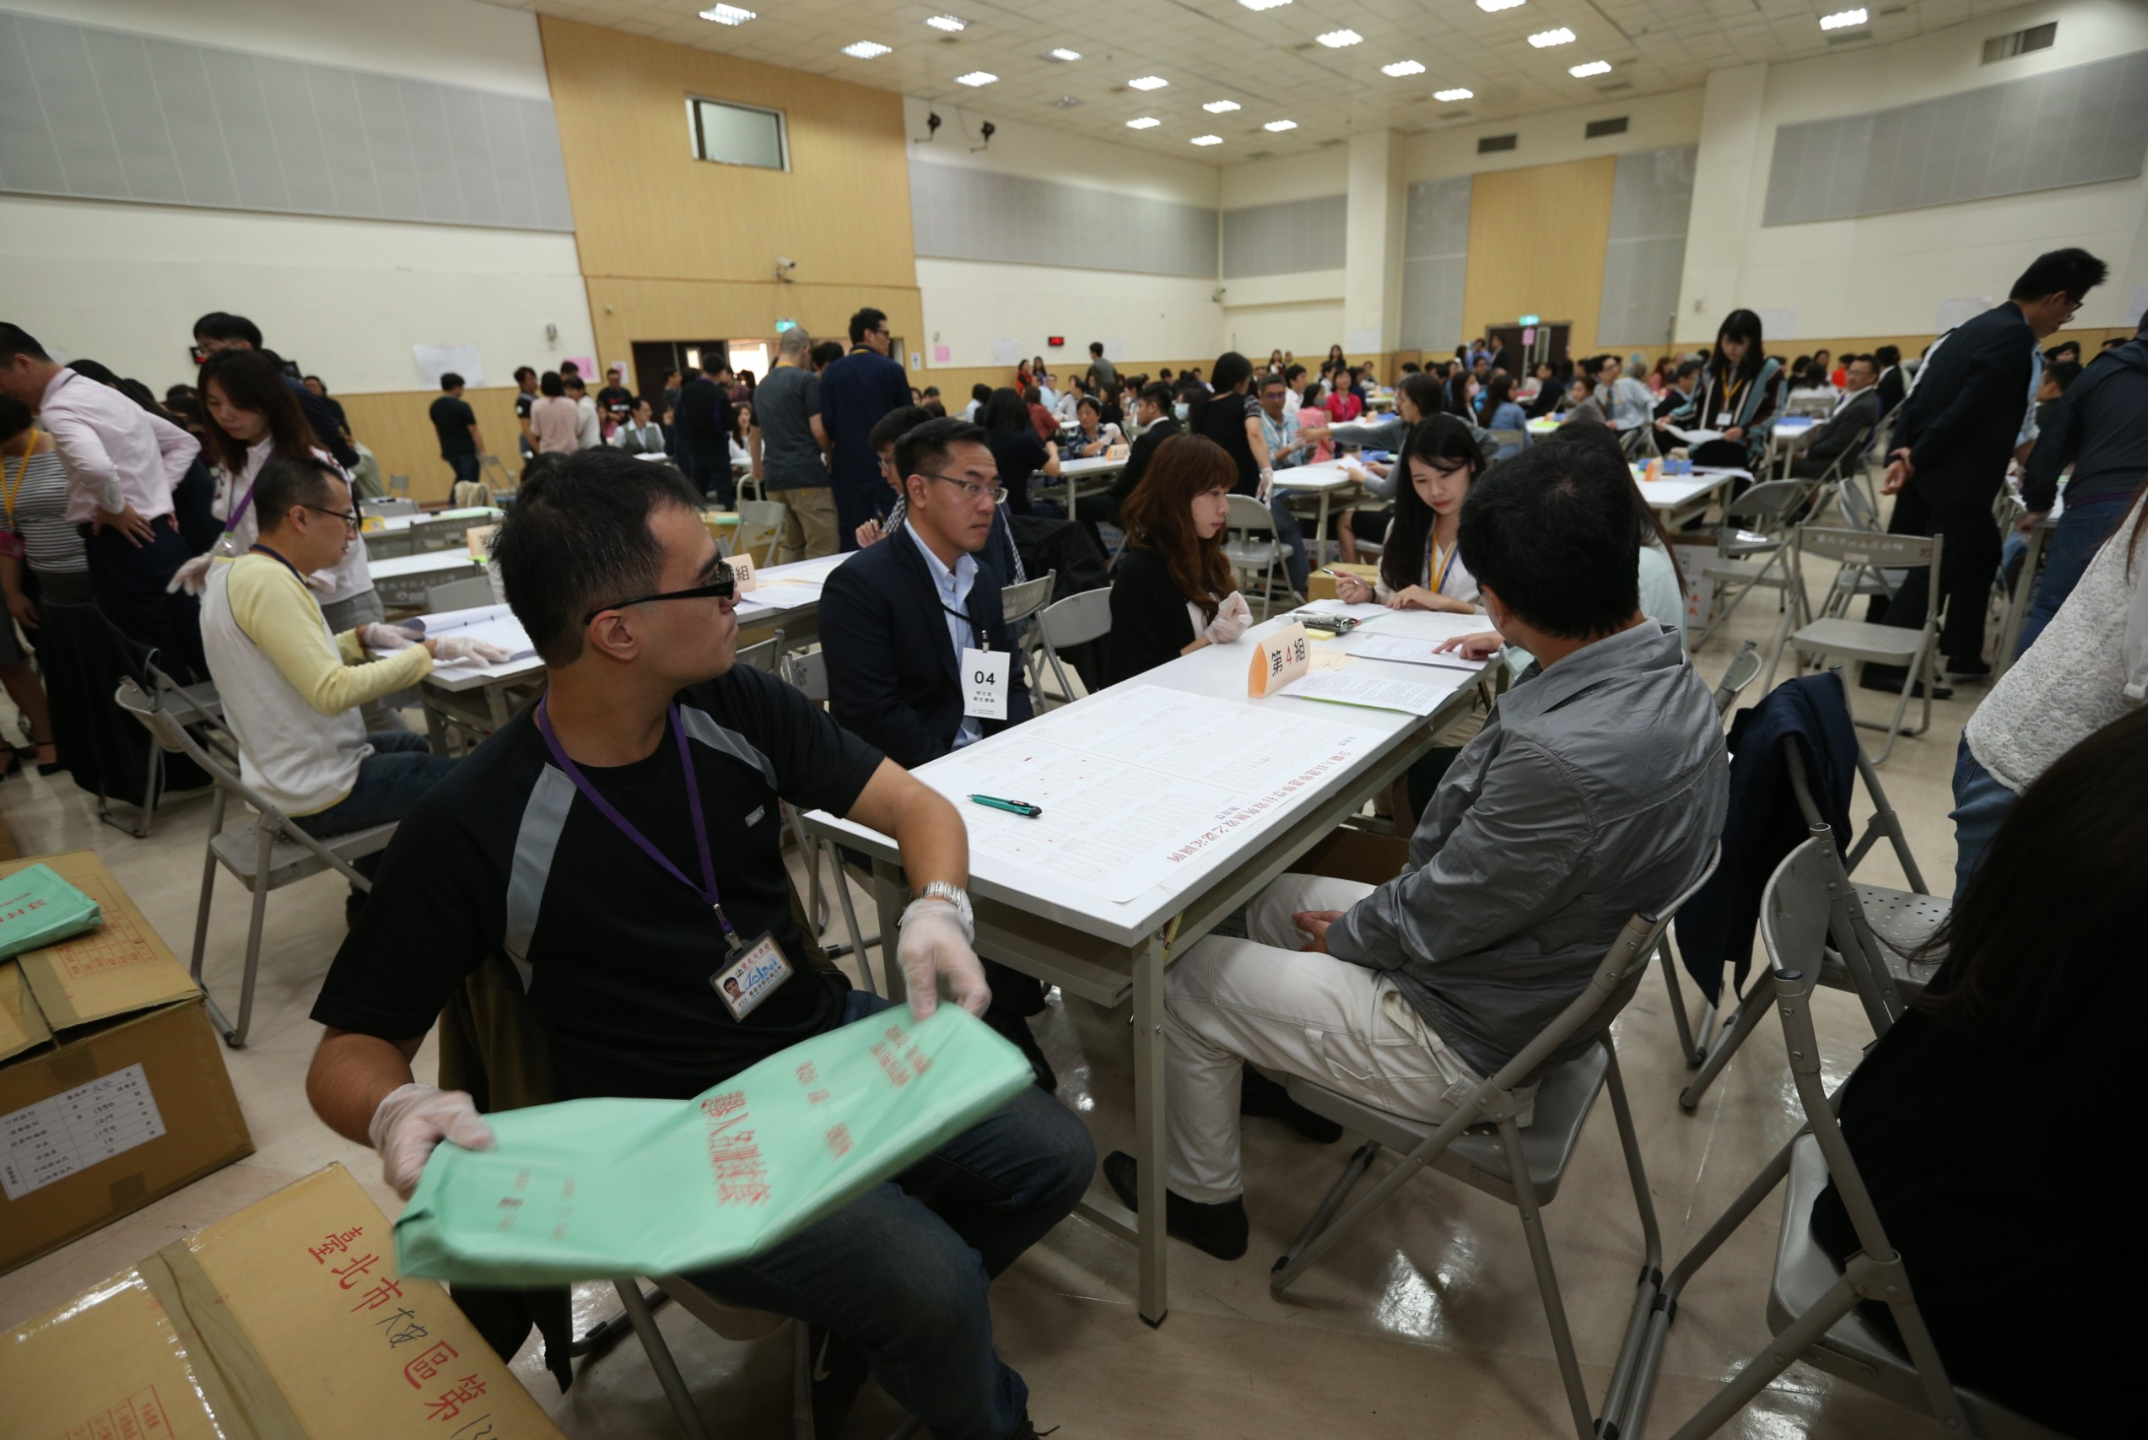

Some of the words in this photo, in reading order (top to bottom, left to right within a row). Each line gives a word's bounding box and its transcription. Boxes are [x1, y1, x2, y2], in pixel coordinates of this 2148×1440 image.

[735, 565, 750, 582] 組
[1271, 637, 1306, 677] 第4組
[974, 670, 996, 686] 04
